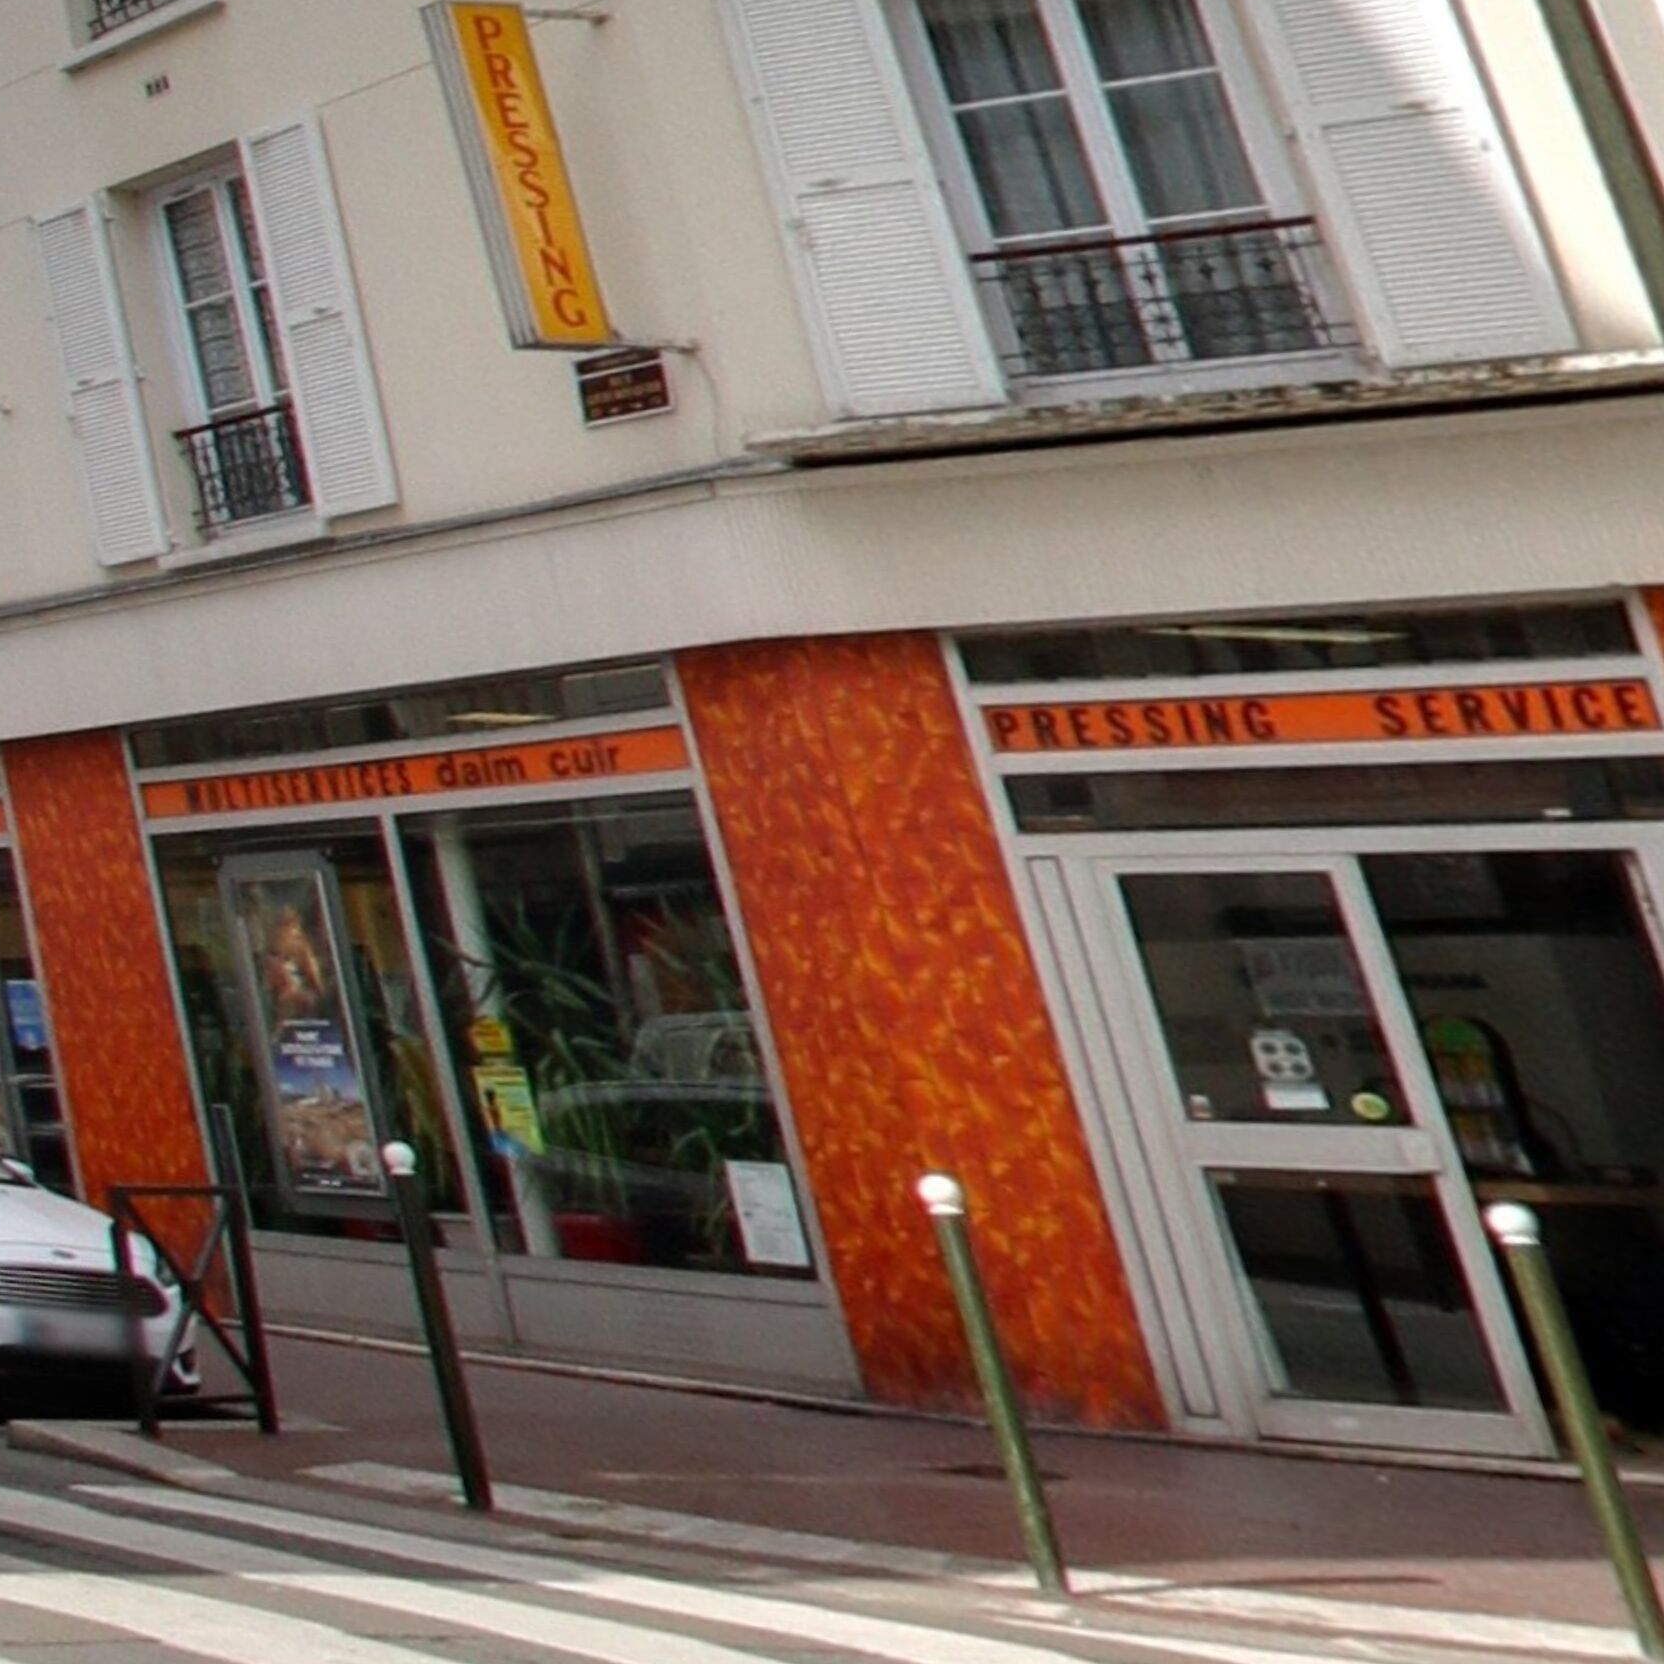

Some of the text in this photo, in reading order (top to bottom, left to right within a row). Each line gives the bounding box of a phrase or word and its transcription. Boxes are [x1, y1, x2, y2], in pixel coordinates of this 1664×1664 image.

[472, 14, 588, 329] PRESSING
[991, 684, 1646, 749] PRESSING SERVICE
[186, 743, 622, 814] MULTISERVICES daim cuir
